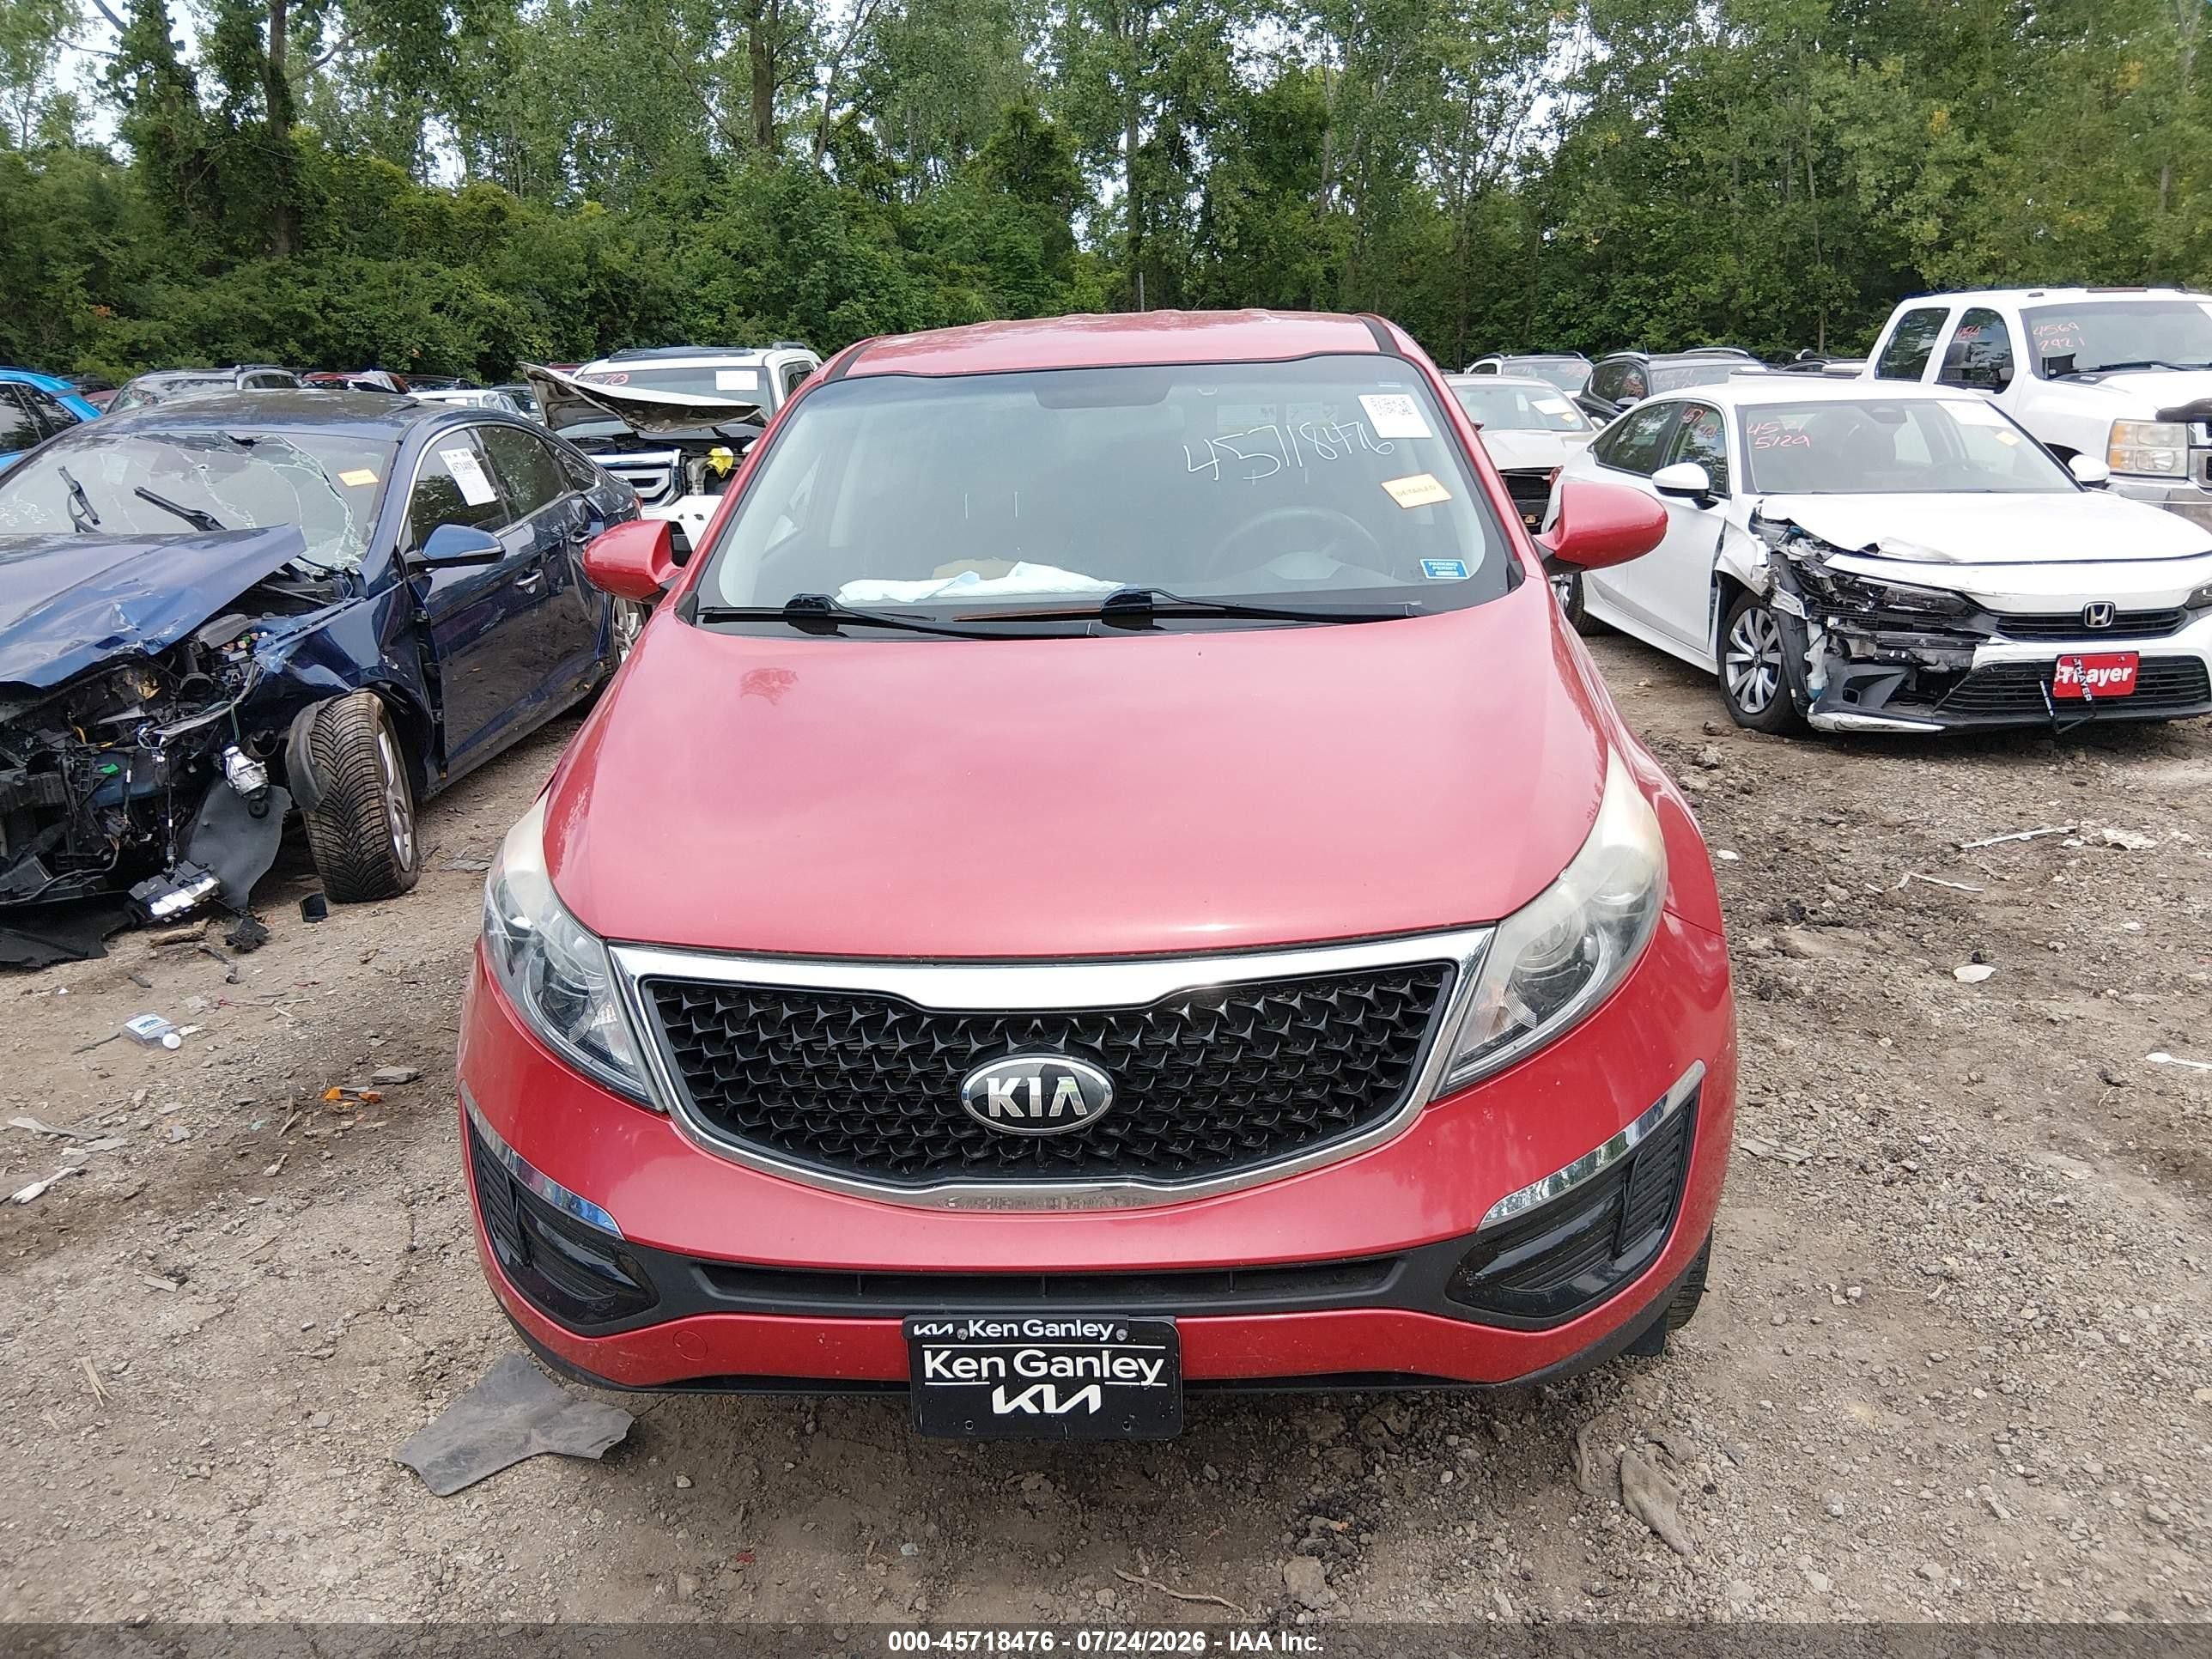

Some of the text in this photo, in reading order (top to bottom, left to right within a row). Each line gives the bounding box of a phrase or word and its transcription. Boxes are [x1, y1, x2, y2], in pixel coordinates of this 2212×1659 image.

[988, 1076, 1088, 1119] KIA
[969, 1320, 1019, 1338] Ken
[1023, 1319, 1115, 1341] Ganley
[925, 1349, 1164, 1388] Ken Ganley
